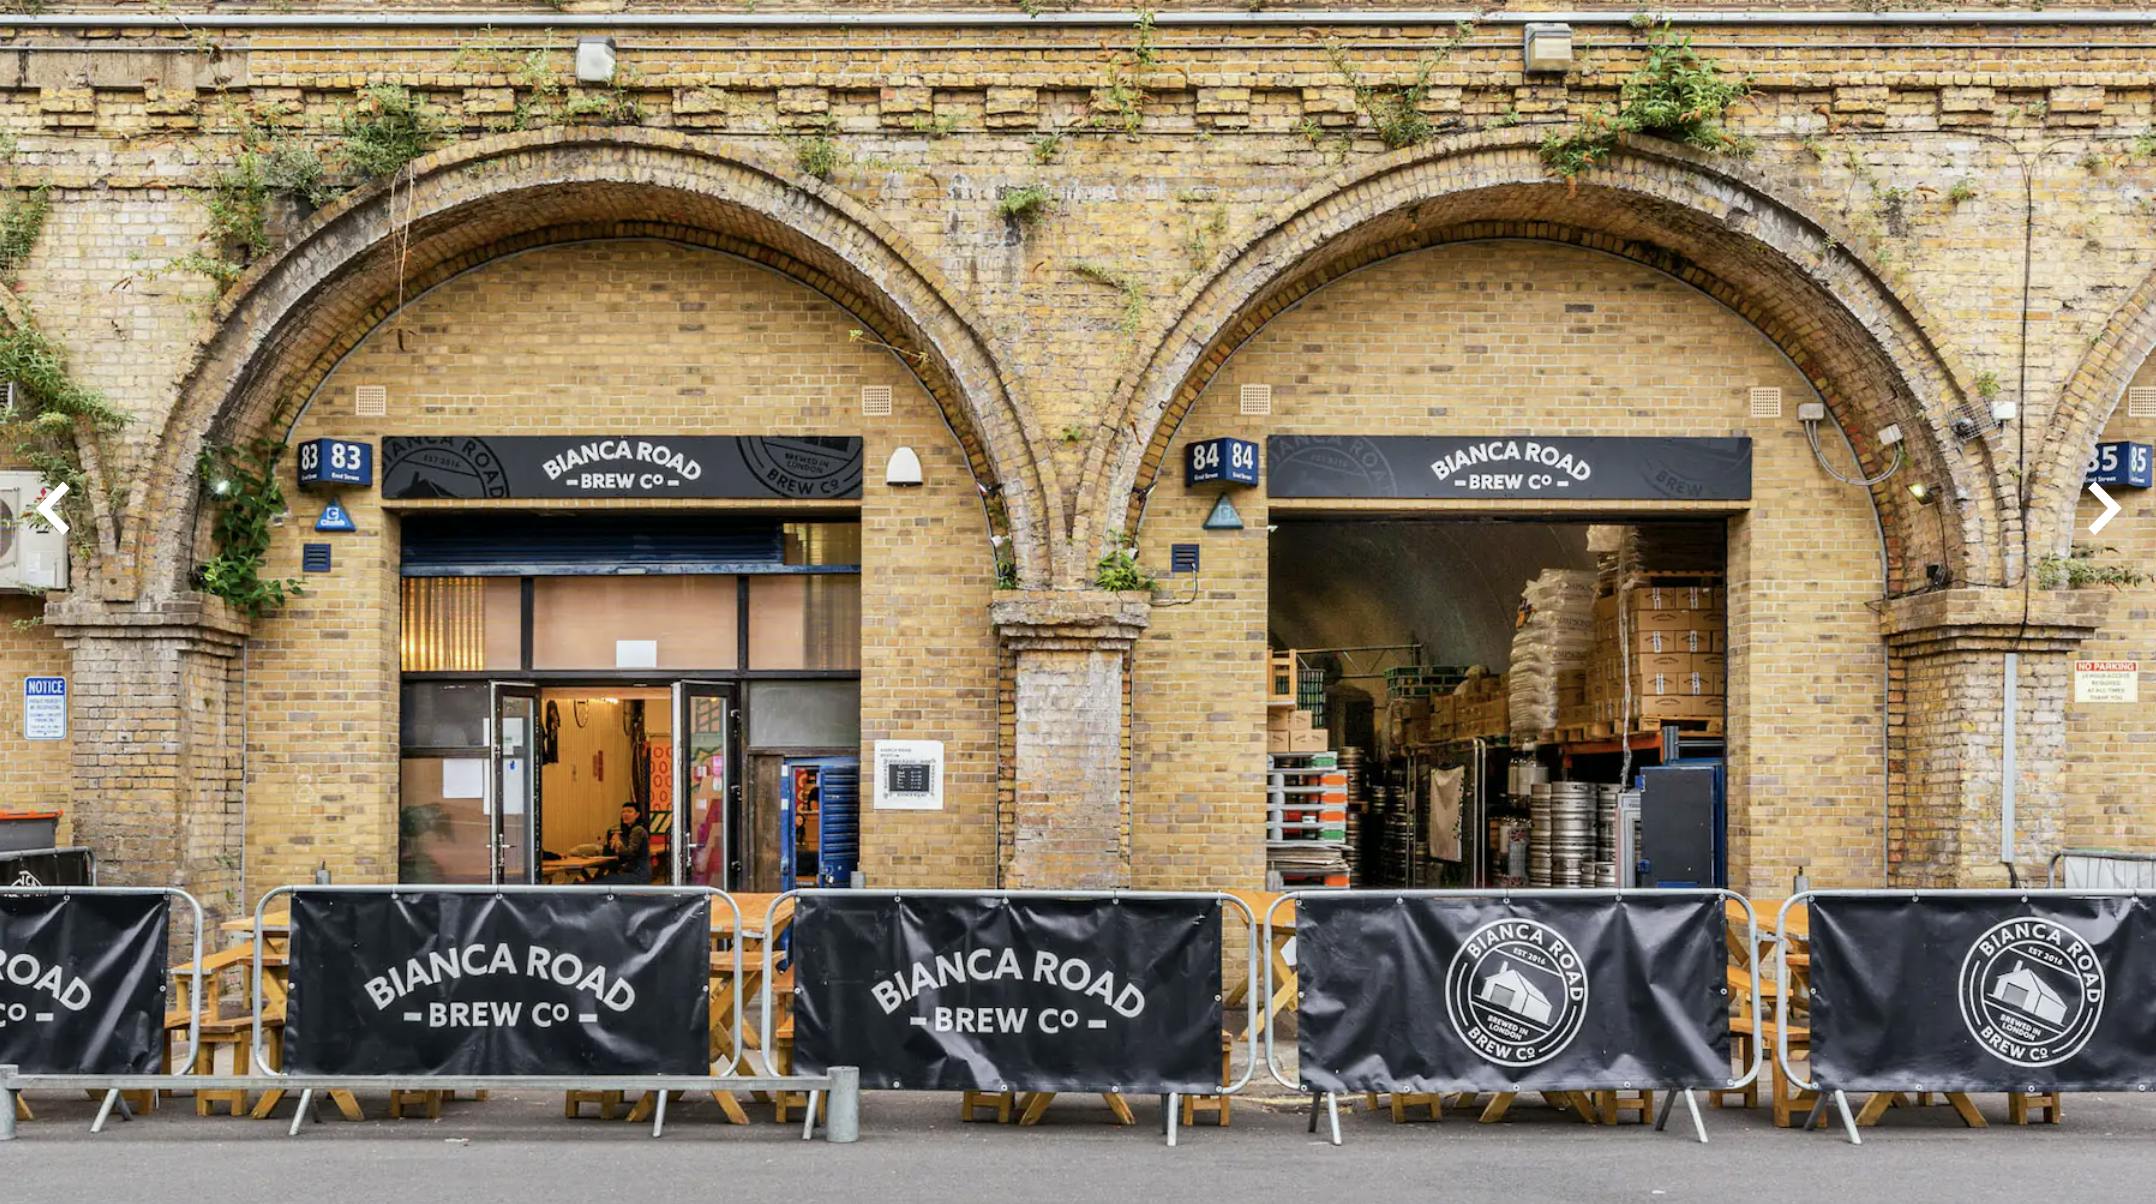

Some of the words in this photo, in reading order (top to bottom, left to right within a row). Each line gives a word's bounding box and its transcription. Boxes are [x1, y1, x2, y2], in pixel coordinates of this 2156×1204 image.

[301, 444, 318, 470] 83
[331, 443, 360, 470] 83
[542, 440, 633, 480] BIANCA
[636, 442, 702, 480] ROAD
[1193, 443, 1219, 470] 84
[1232, 442, 1253, 469] 84
[1430, 441, 1521, 480] BIANCA
[1524, 442, 1591, 480] ROAD
[2131, 446, 2147, 472] 85
[581, 473, 635, 488] BREW
[767, 468, 814, 494] BREW
[1469, 474, 1523, 489] BREW
[2079, 662, 2092, 670] NO
[2095, 662, 2134, 670] PARKING
[28, 680, 64, 694] NOTICE
[1467, 923, 1544, 959] BIANCA
[1548, 939, 1584, 1001] ROAD
[1513, 947, 1526, 957] EST
[1528, 952, 1547, 965] 2016
[1979, 923, 2062, 957] BIANCA
[2066, 941, 2101, 1003] ROAD
[2028, 946, 2042, 957] EST
[2044, 951, 2063, 966] 2016
[364, 943, 517, 1010] BIANCA
[526, 945, 636, 1012] ROAD
[870, 948, 1023, 1015] BIANCA
[1033, 950, 1145, 1018] ROAD
[429, 1002, 522, 1027] BREW
[935, 1006, 1028, 1033] BREW
[1487, 1015, 1518, 1031] BREWED
[1519, 1027, 1529, 1036] IN
[2000, 1014, 2032, 1032] BREWED
[2032, 1027, 2042, 1036] IN
[1467, 1026, 1512, 1059] BREW
[1488, 1023, 1522, 1041] LONDON
[1980, 1026, 2026, 1059] BREW
[2001, 1023, 2036, 1041] LONDON
